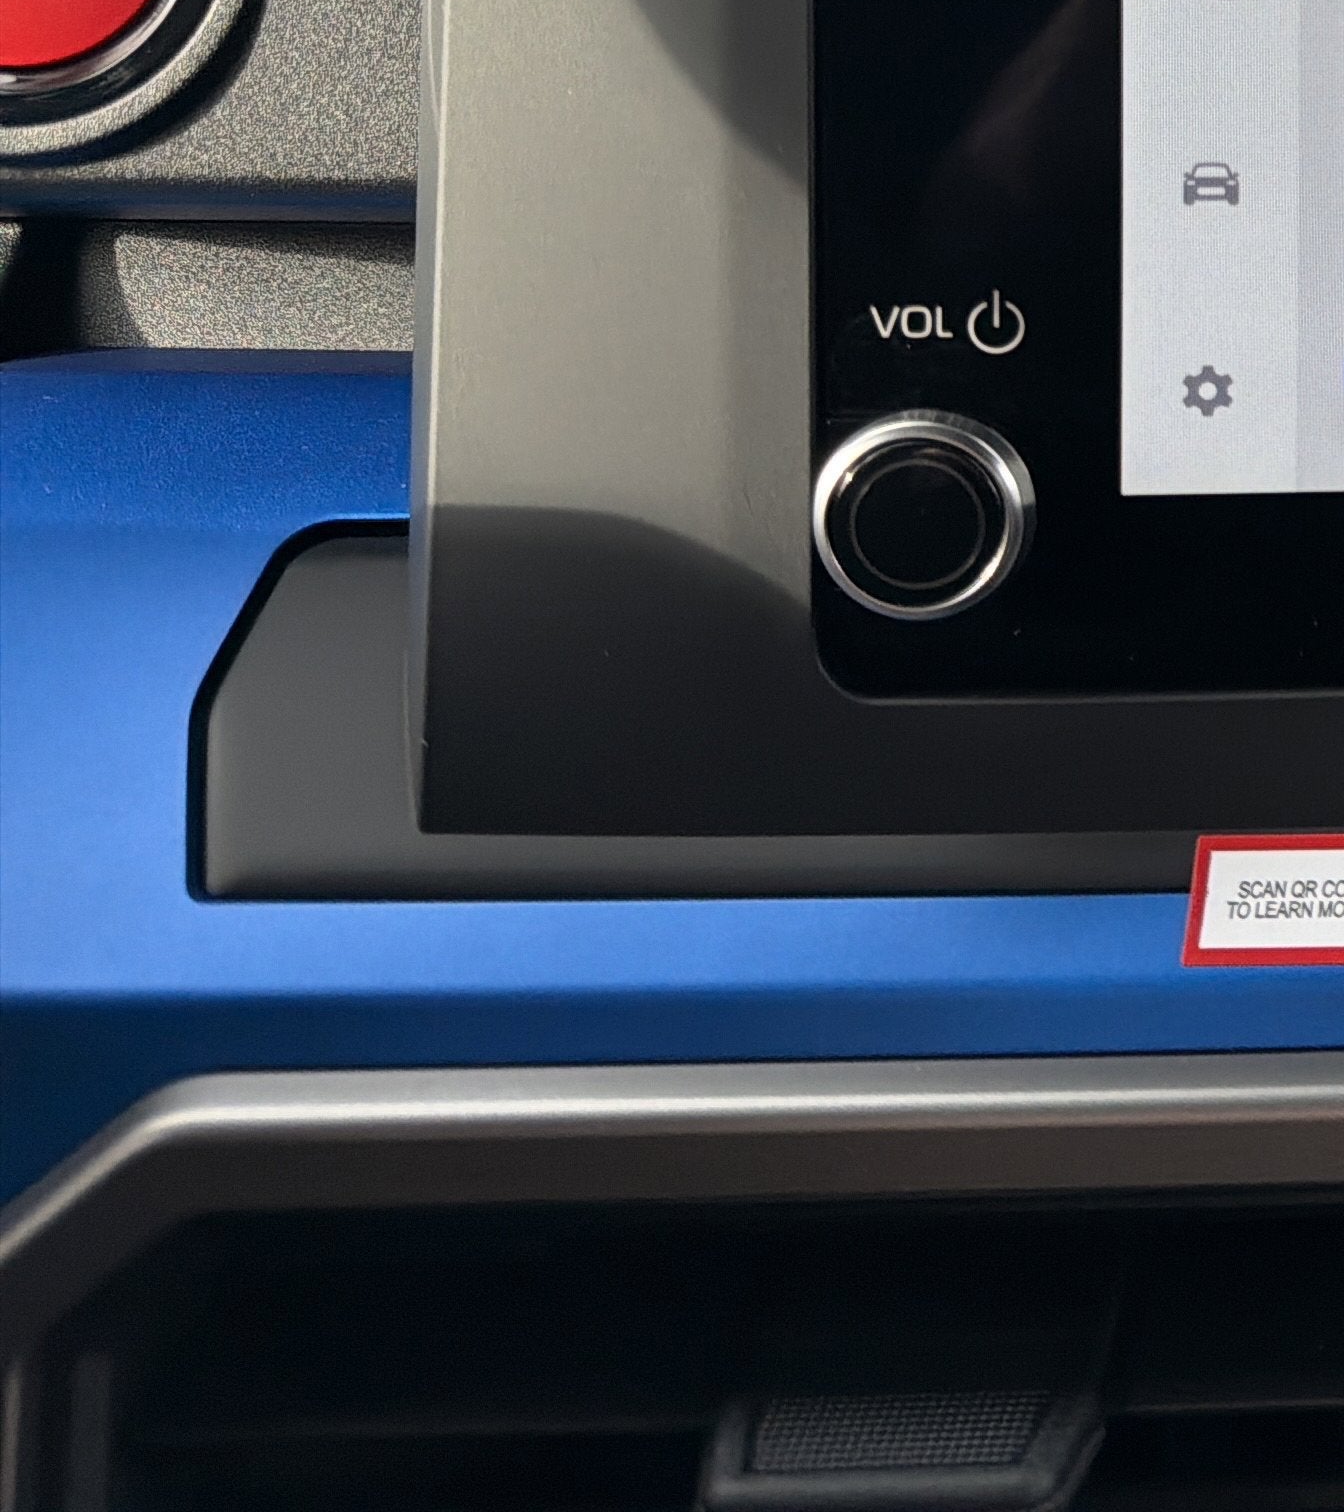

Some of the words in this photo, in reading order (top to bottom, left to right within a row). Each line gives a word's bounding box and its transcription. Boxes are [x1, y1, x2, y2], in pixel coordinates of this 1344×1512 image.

[869, 304, 954, 338] VOL
[1238, 880, 1287, 899] SCAN
[1290, 880, 1318, 899] QR
[1228, 901, 1251, 919] TO
[1254, 901, 1314, 919] LEARN
